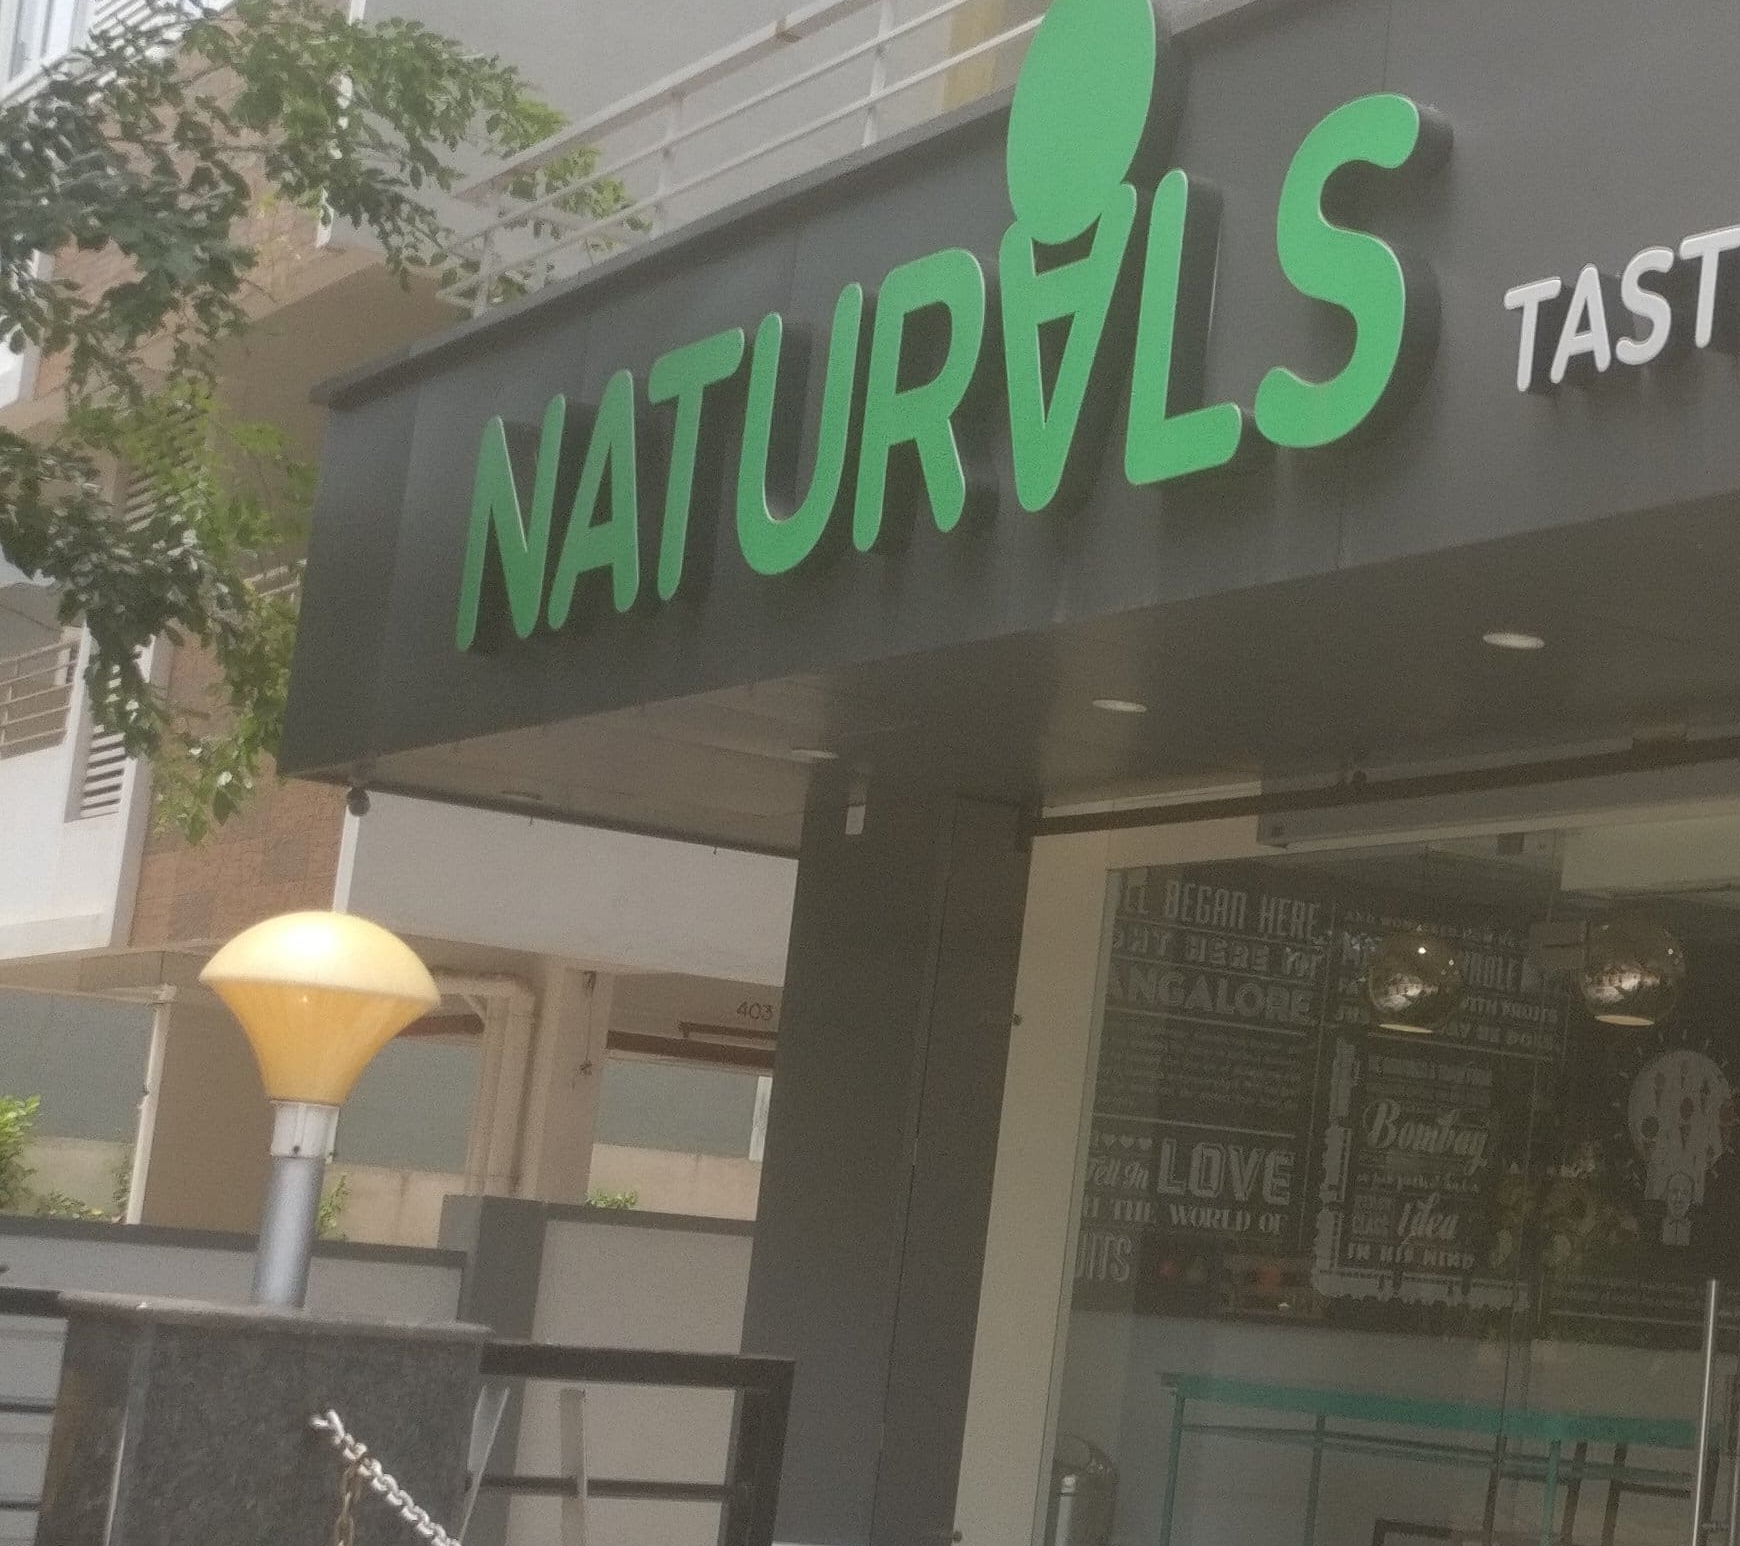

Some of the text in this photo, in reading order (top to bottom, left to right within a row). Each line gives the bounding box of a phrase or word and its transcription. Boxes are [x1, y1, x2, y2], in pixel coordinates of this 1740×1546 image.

[455, 91, 1421, 653] NATURALS
[1163, 879, 1248, 930] BEGAN
[1258, 894, 1321, 941] HERE
[736, 1001, 772, 1021] 403
[1361, 1097, 1488, 1177] Bombay
[1156, 1137, 1296, 1206] LOVE
[1169, 1204, 1252, 1232] WORLD
